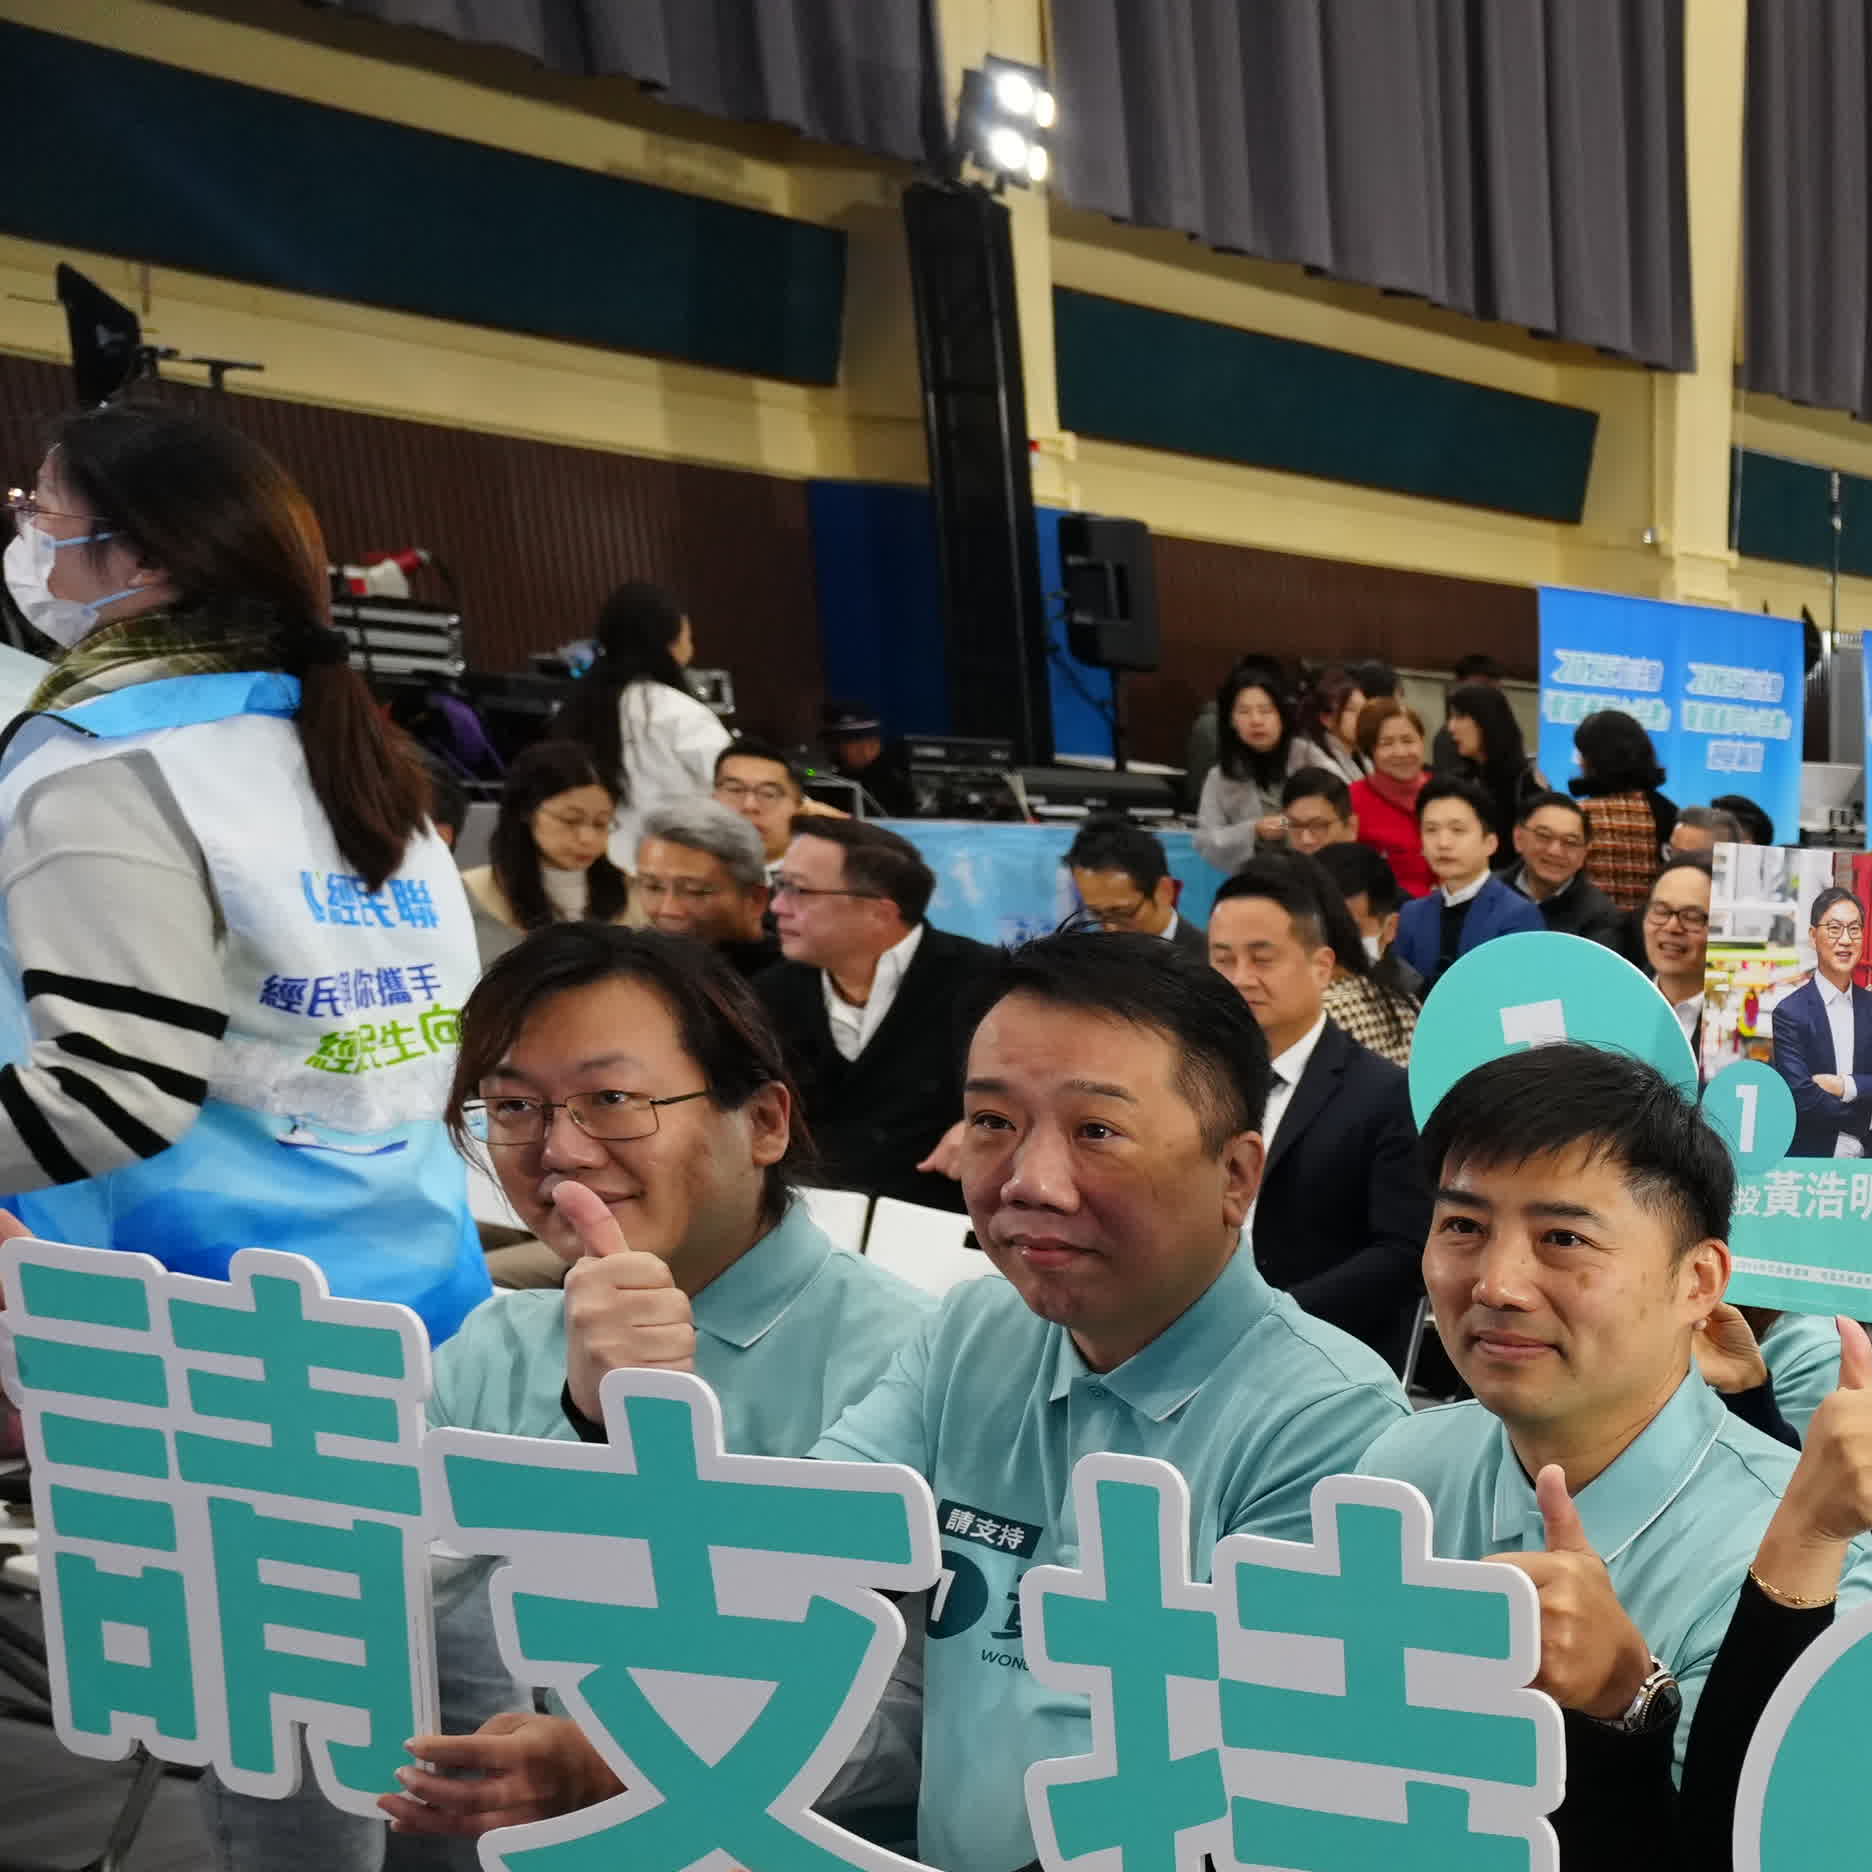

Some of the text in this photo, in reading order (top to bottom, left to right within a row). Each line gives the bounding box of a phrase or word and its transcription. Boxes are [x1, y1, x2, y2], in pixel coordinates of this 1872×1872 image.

[1735, 1084, 1758, 1153] 1
[945, 1508, 1025, 1551] 請支持
[931, 1568, 957, 1623] 1
